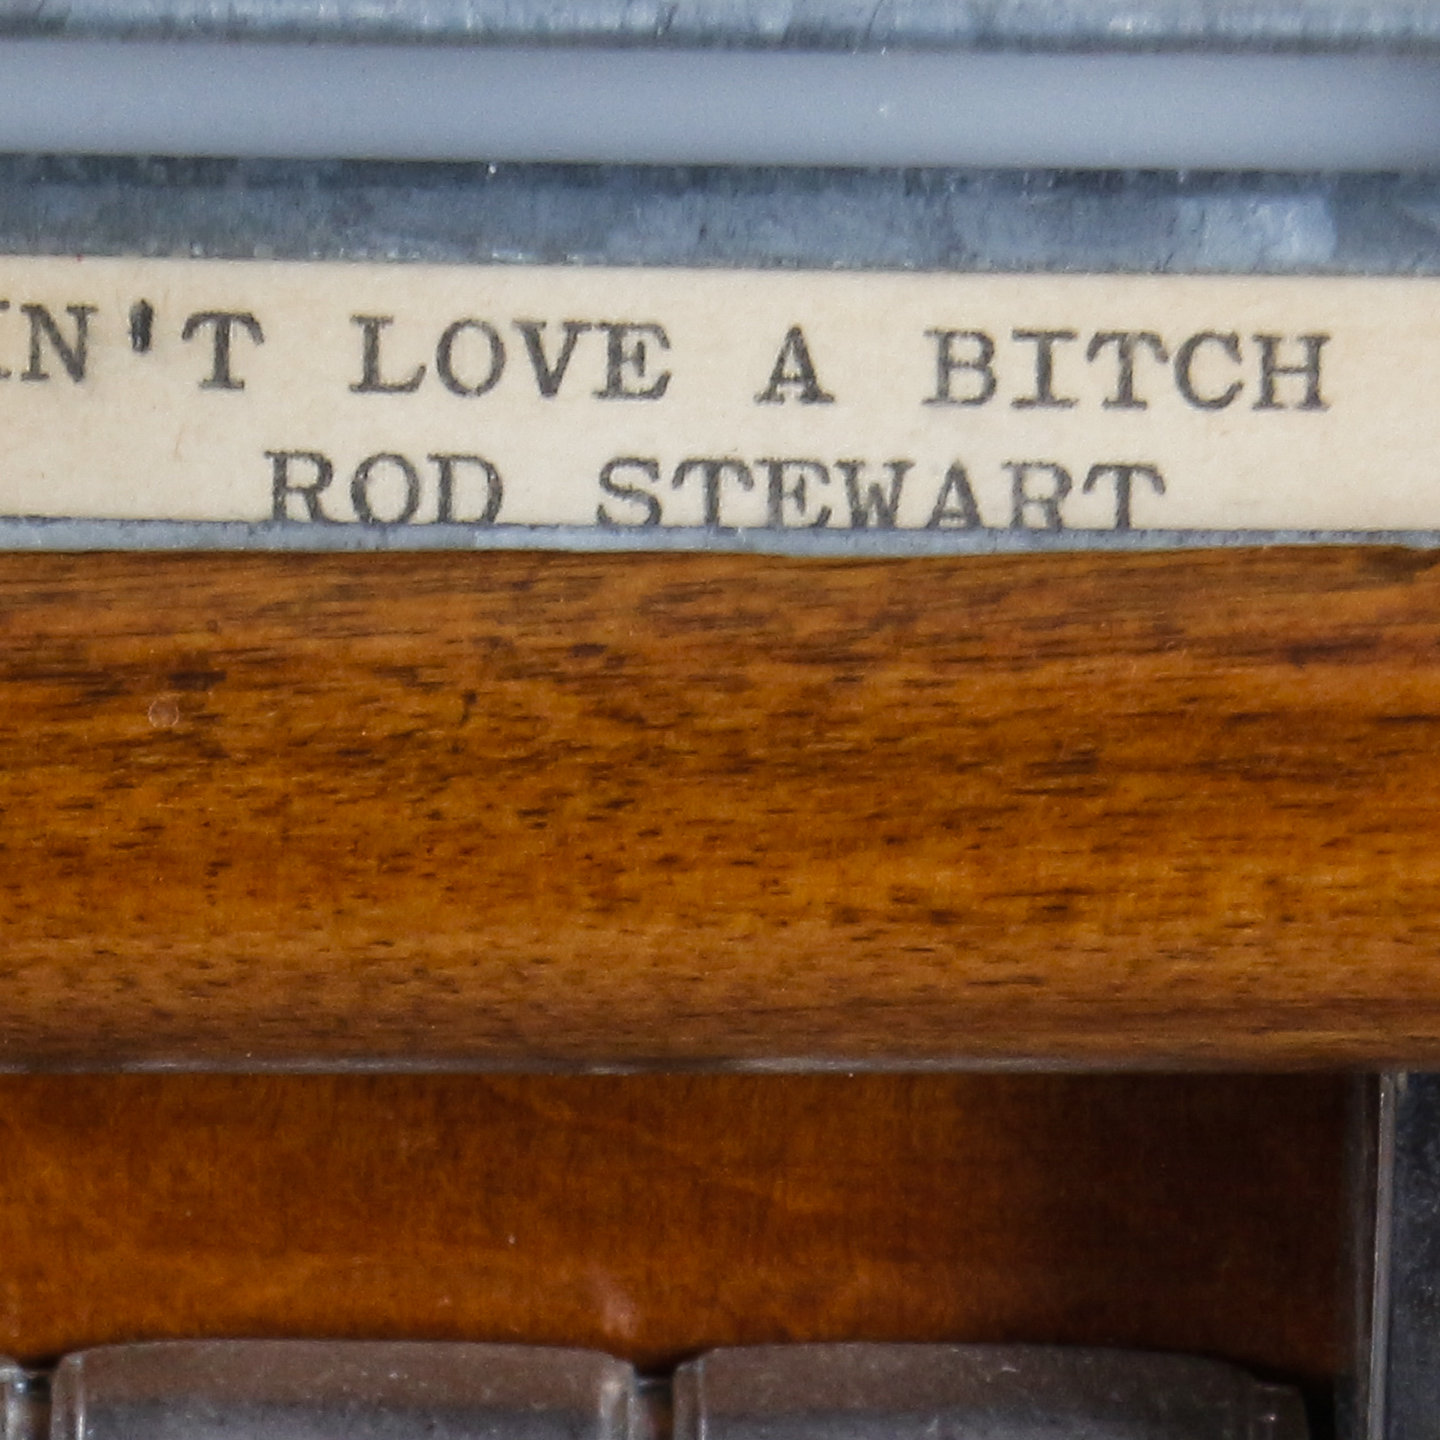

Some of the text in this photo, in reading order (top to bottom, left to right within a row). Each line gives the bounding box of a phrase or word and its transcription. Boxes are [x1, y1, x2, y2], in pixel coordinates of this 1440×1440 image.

[349, 314, 673, 401] LOVE
[755, 324, 835, 404] A
[921, 326, 1333, 412] BITCH
[263, 449, 1167, 530] ROD STEWART
